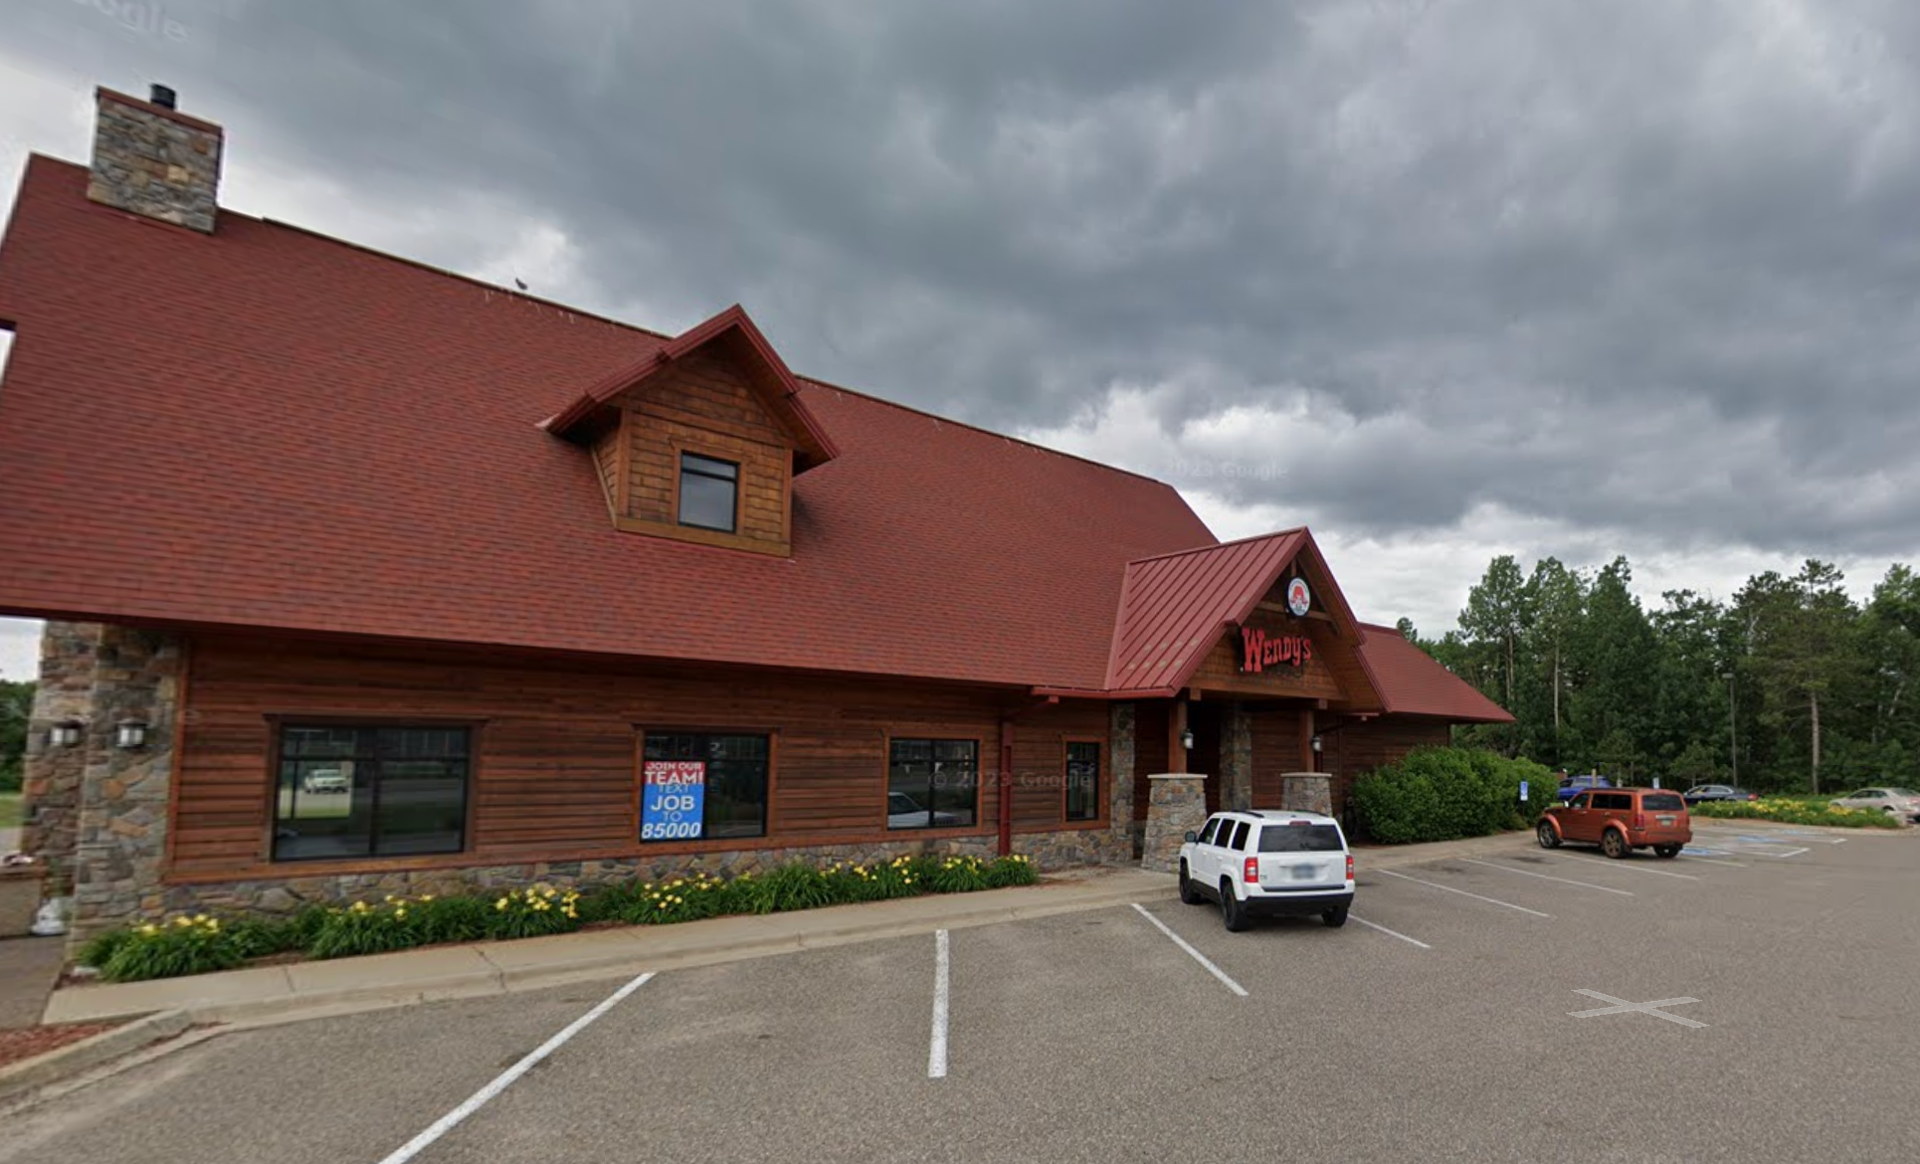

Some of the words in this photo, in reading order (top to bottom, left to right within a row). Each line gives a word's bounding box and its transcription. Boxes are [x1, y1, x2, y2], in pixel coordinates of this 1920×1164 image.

[646, 761, 676, 770] JOIN
[678, 761, 702, 770] OUR
[644, 770, 704, 785] TEAM!
[657, 784, 690, 793] TEXT
[650, 795, 695, 811] JOB
[661, 811, 683, 822] TO
[641, 822, 701, 839] 85000
